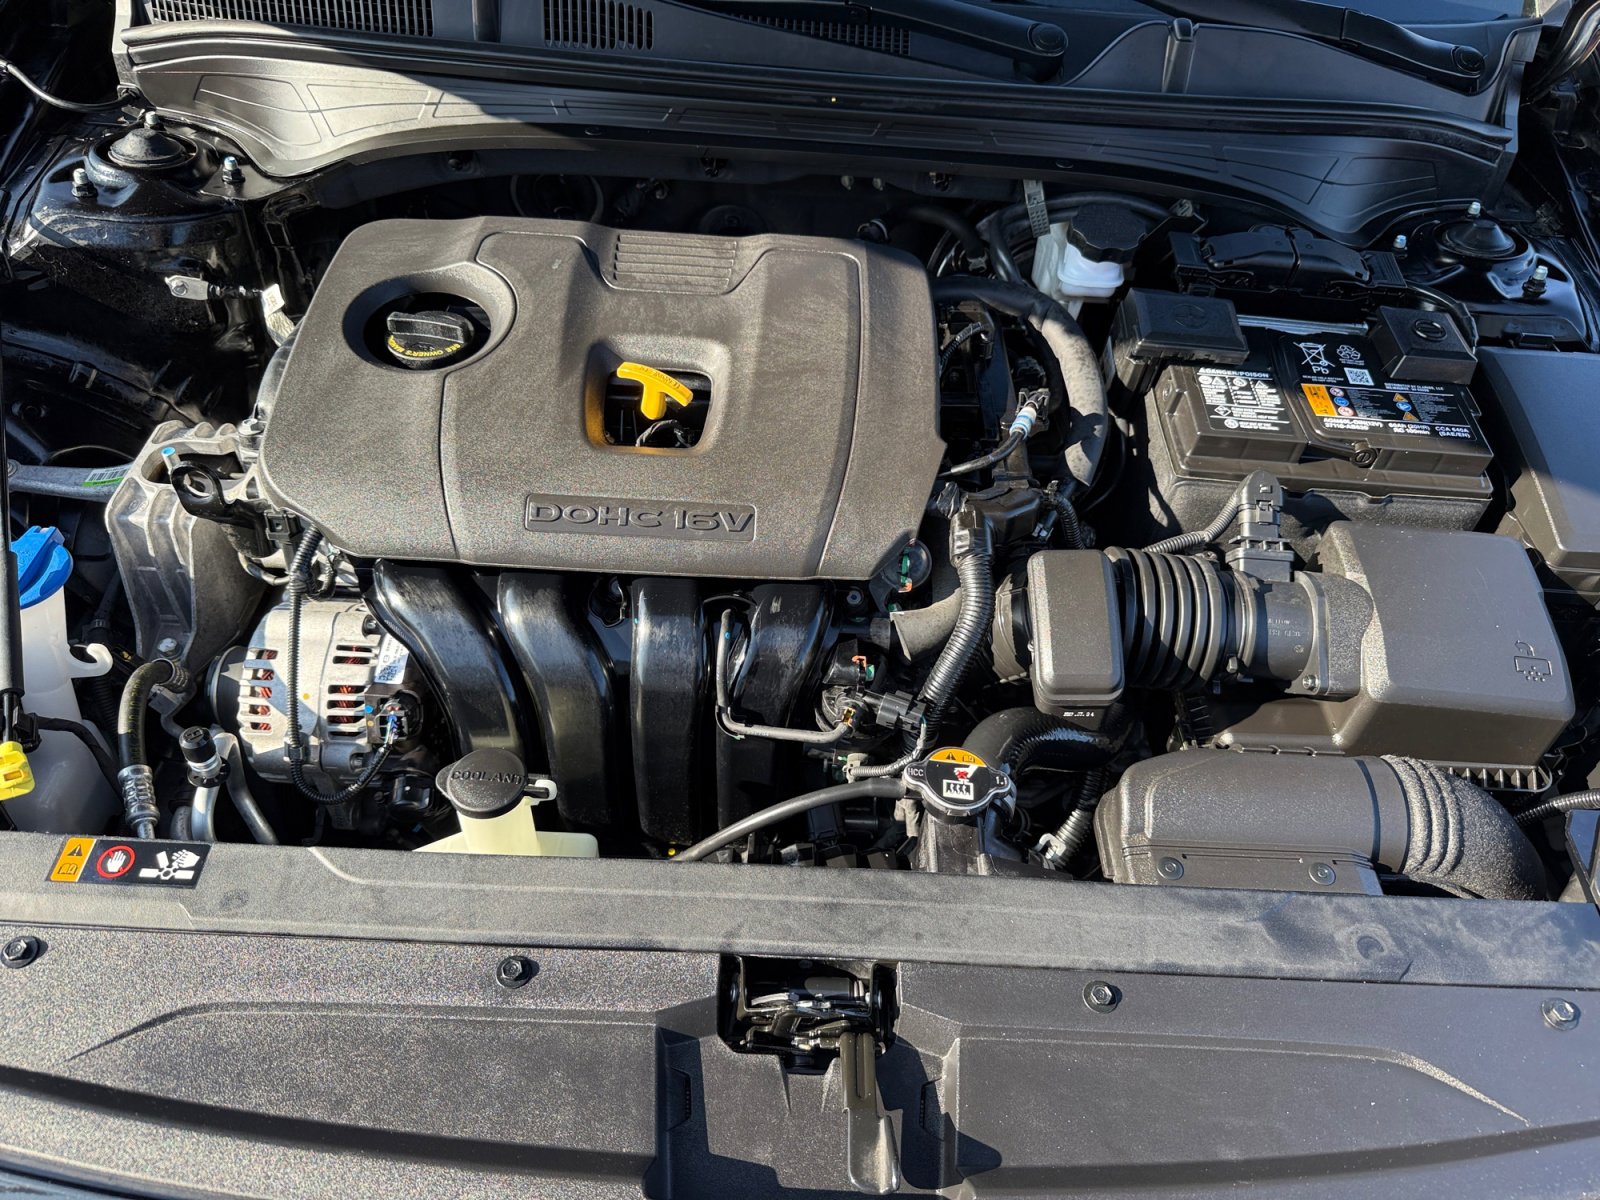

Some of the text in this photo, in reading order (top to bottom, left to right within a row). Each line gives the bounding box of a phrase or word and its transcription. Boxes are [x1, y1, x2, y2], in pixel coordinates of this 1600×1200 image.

[1312, 366, 1329, 374] Pb
[529, 502, 754, 532] DOHC 16V
[451, 770, 522, 785] COOLANT
[907, 768, 924, 777] HCC
[996, 776, 1008, 786] 1.1
